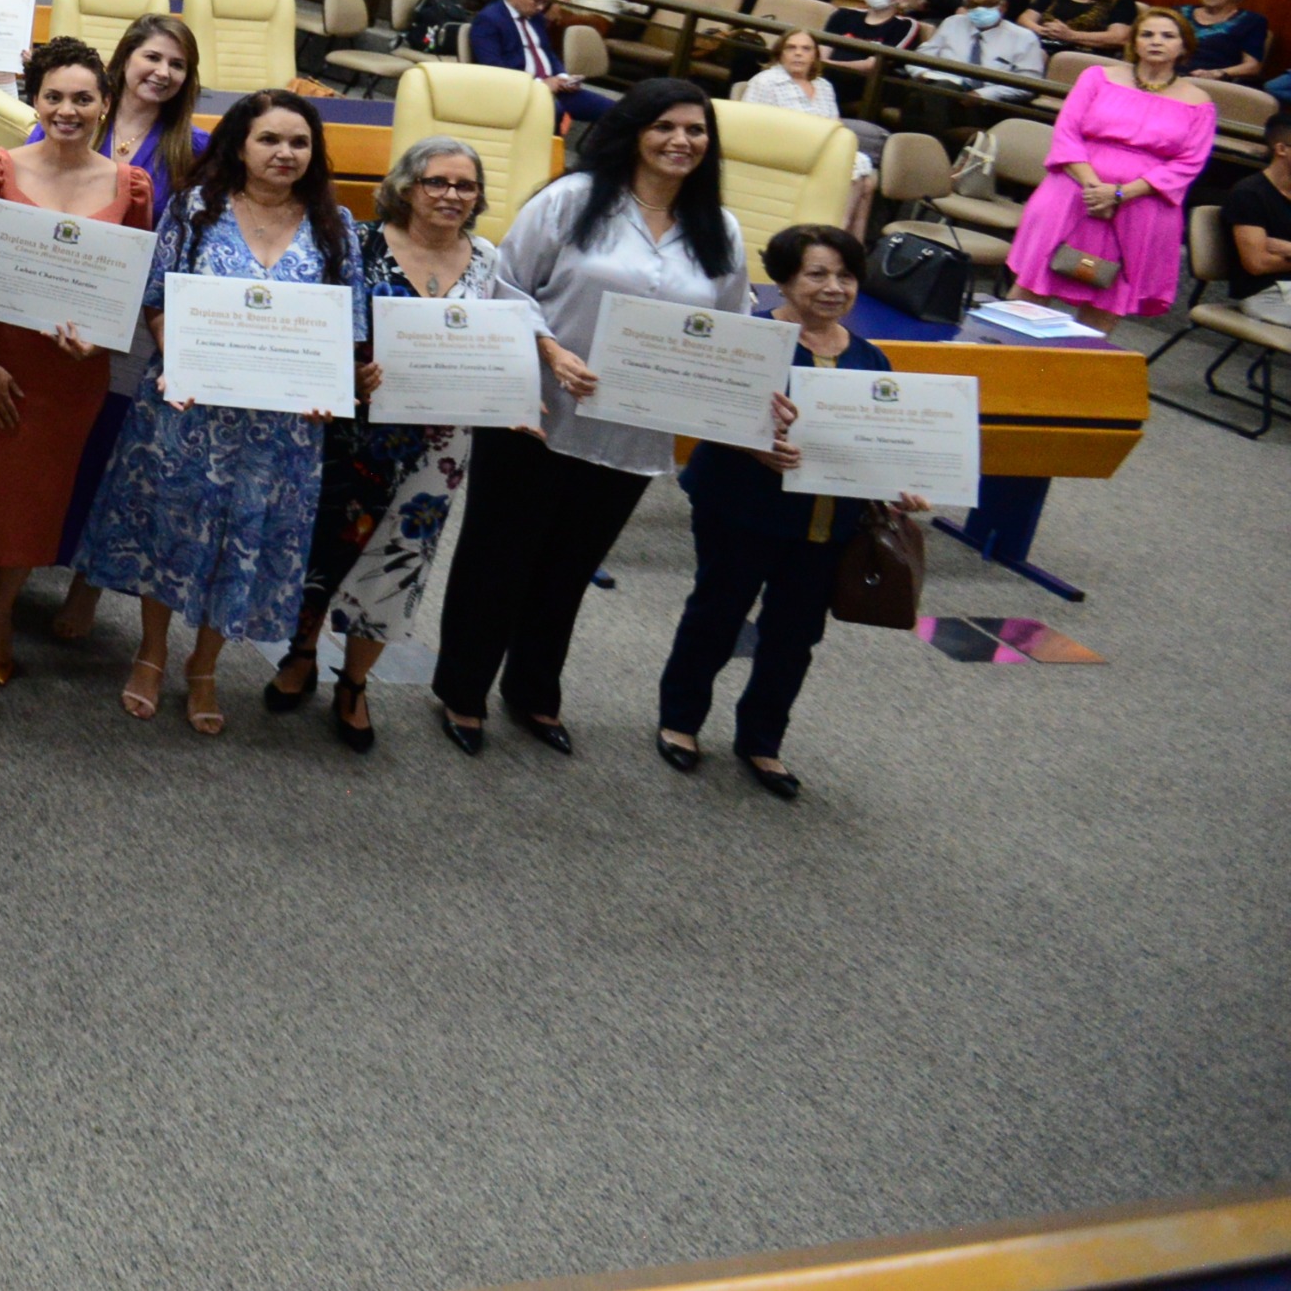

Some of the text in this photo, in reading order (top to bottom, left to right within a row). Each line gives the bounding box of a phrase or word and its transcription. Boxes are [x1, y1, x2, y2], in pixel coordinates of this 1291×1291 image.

[39, 240, 48, 250] de
[51, 243, 80, 257] Honra
[82, 252, 93, 260] ao
[95, 253, 127, 269] Mérito
[71, 277, 98, 289] Martins
[190, 307, 230, 319] Diploma
[232, 310, 243, 320] de
[246, 312, 276, 323] Honra
[293, 316, 327, 327] Mérito
[195, 339, 225, 347] Luciana
[269, 345, 299, 353] Santana
